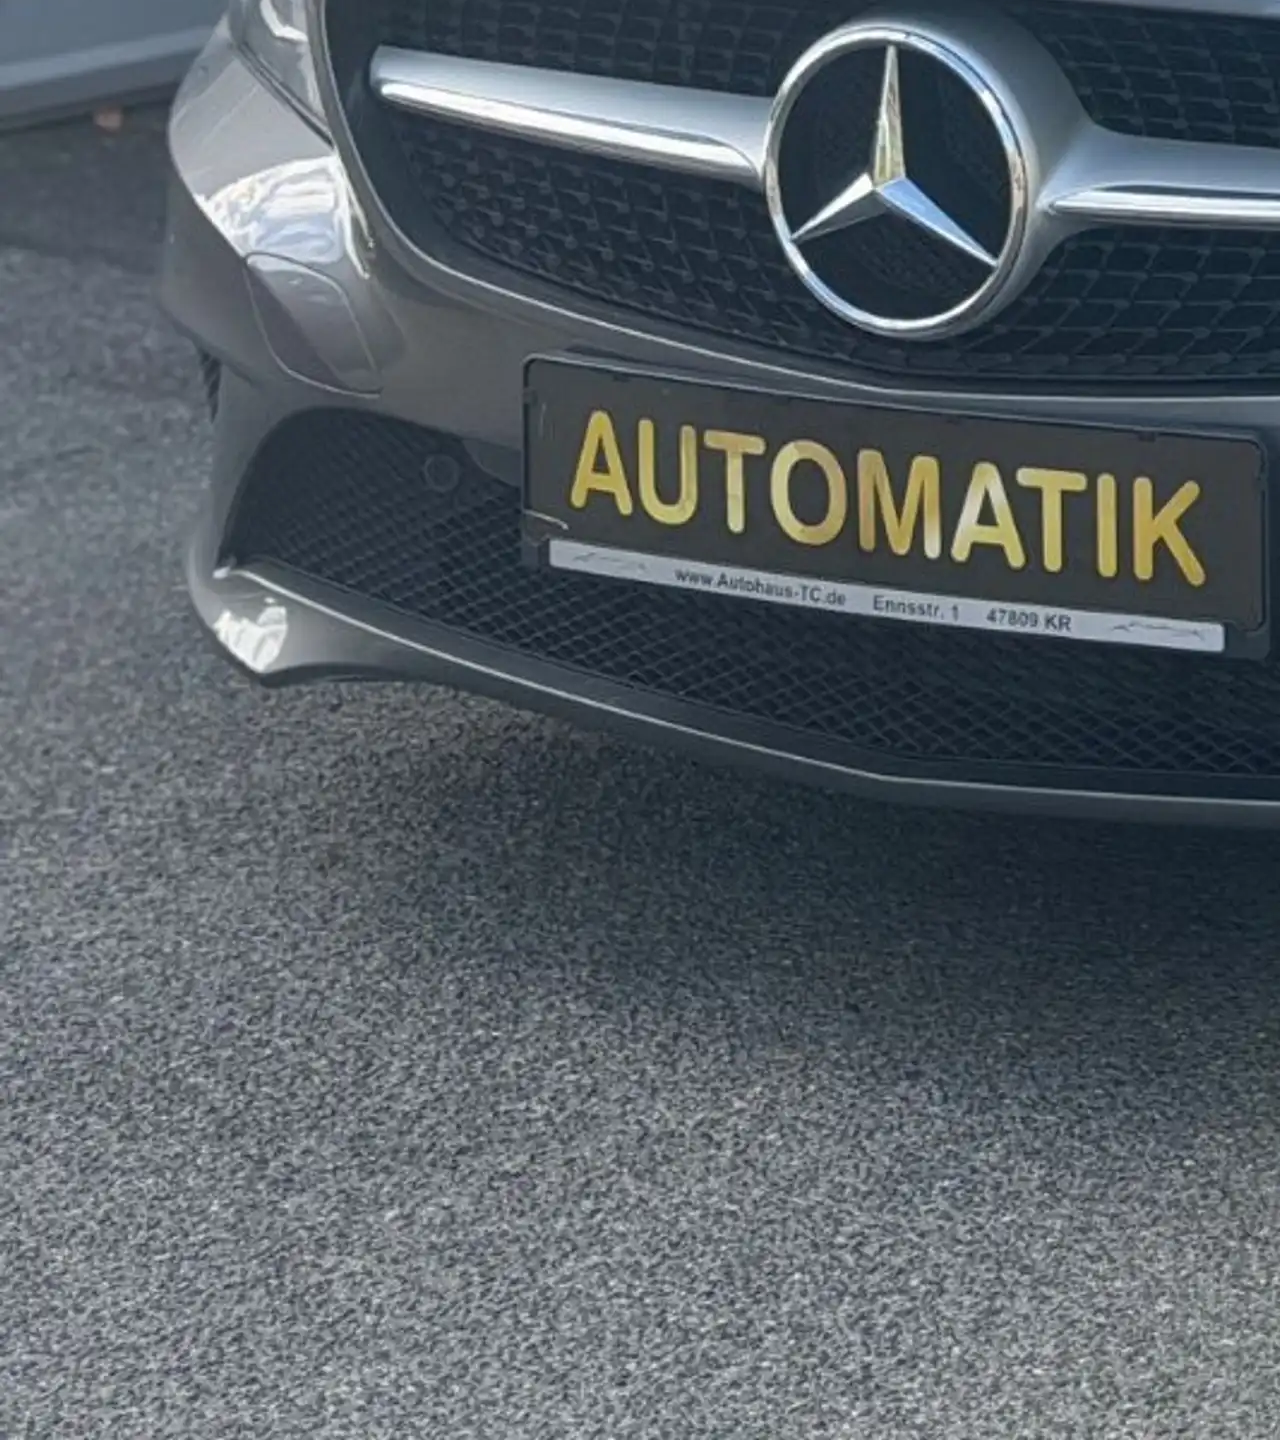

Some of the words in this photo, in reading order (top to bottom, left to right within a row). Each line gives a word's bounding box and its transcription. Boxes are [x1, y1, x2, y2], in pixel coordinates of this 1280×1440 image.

[569, 410, 1206, 587] AUTOMATIK
[674, 568, 846, 607] www.Autohaus-TC.de
[873, 594, 945, 621] Ennsstr.
[950, 606, 959, 622] 1
[986, 608, 1039, 629] 47809
[1045, 615, 1071, 632] KR
